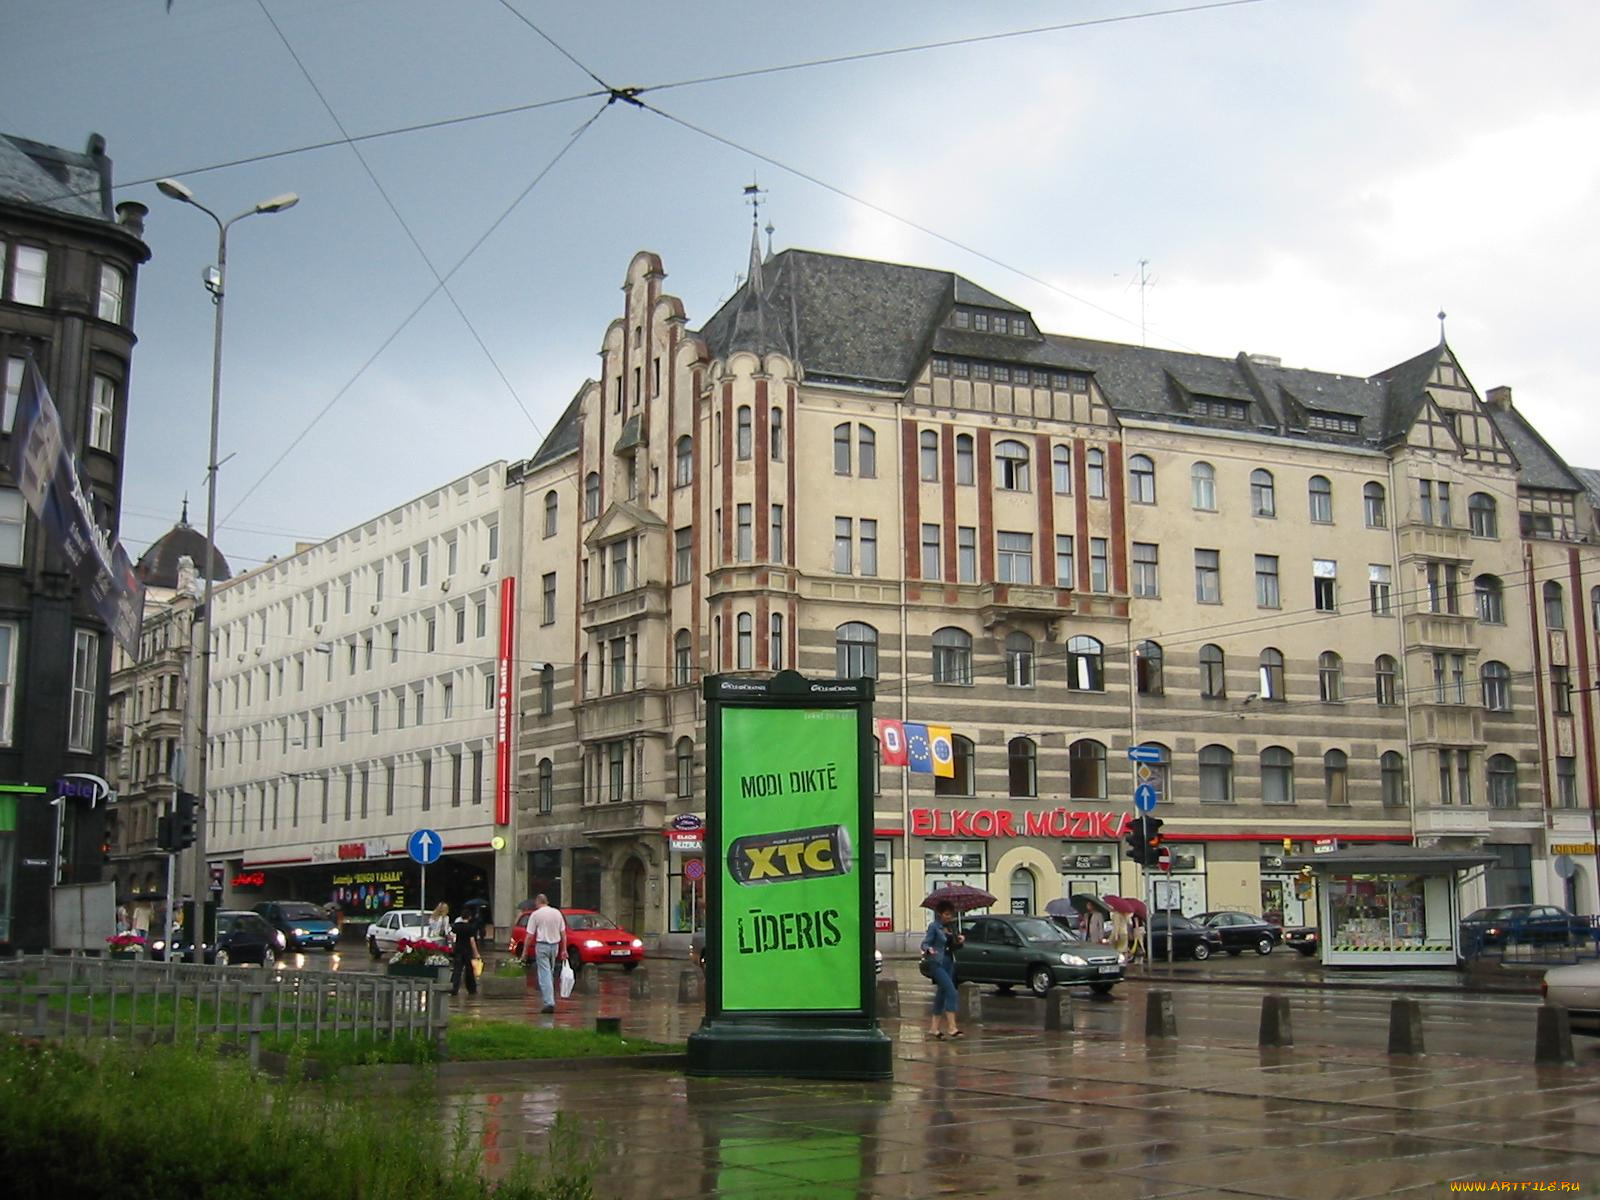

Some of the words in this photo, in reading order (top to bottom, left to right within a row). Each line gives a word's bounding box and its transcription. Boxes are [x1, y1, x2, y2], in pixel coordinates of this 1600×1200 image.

[741, 773, 783, 798] MODI
[789, 762, 838, 793] DIKTĒ
[910, 808, 1017, 837] ELKOR
[745, 839, 835, 879] XTC
[738, 908, 841, 954] LĪDERIS
